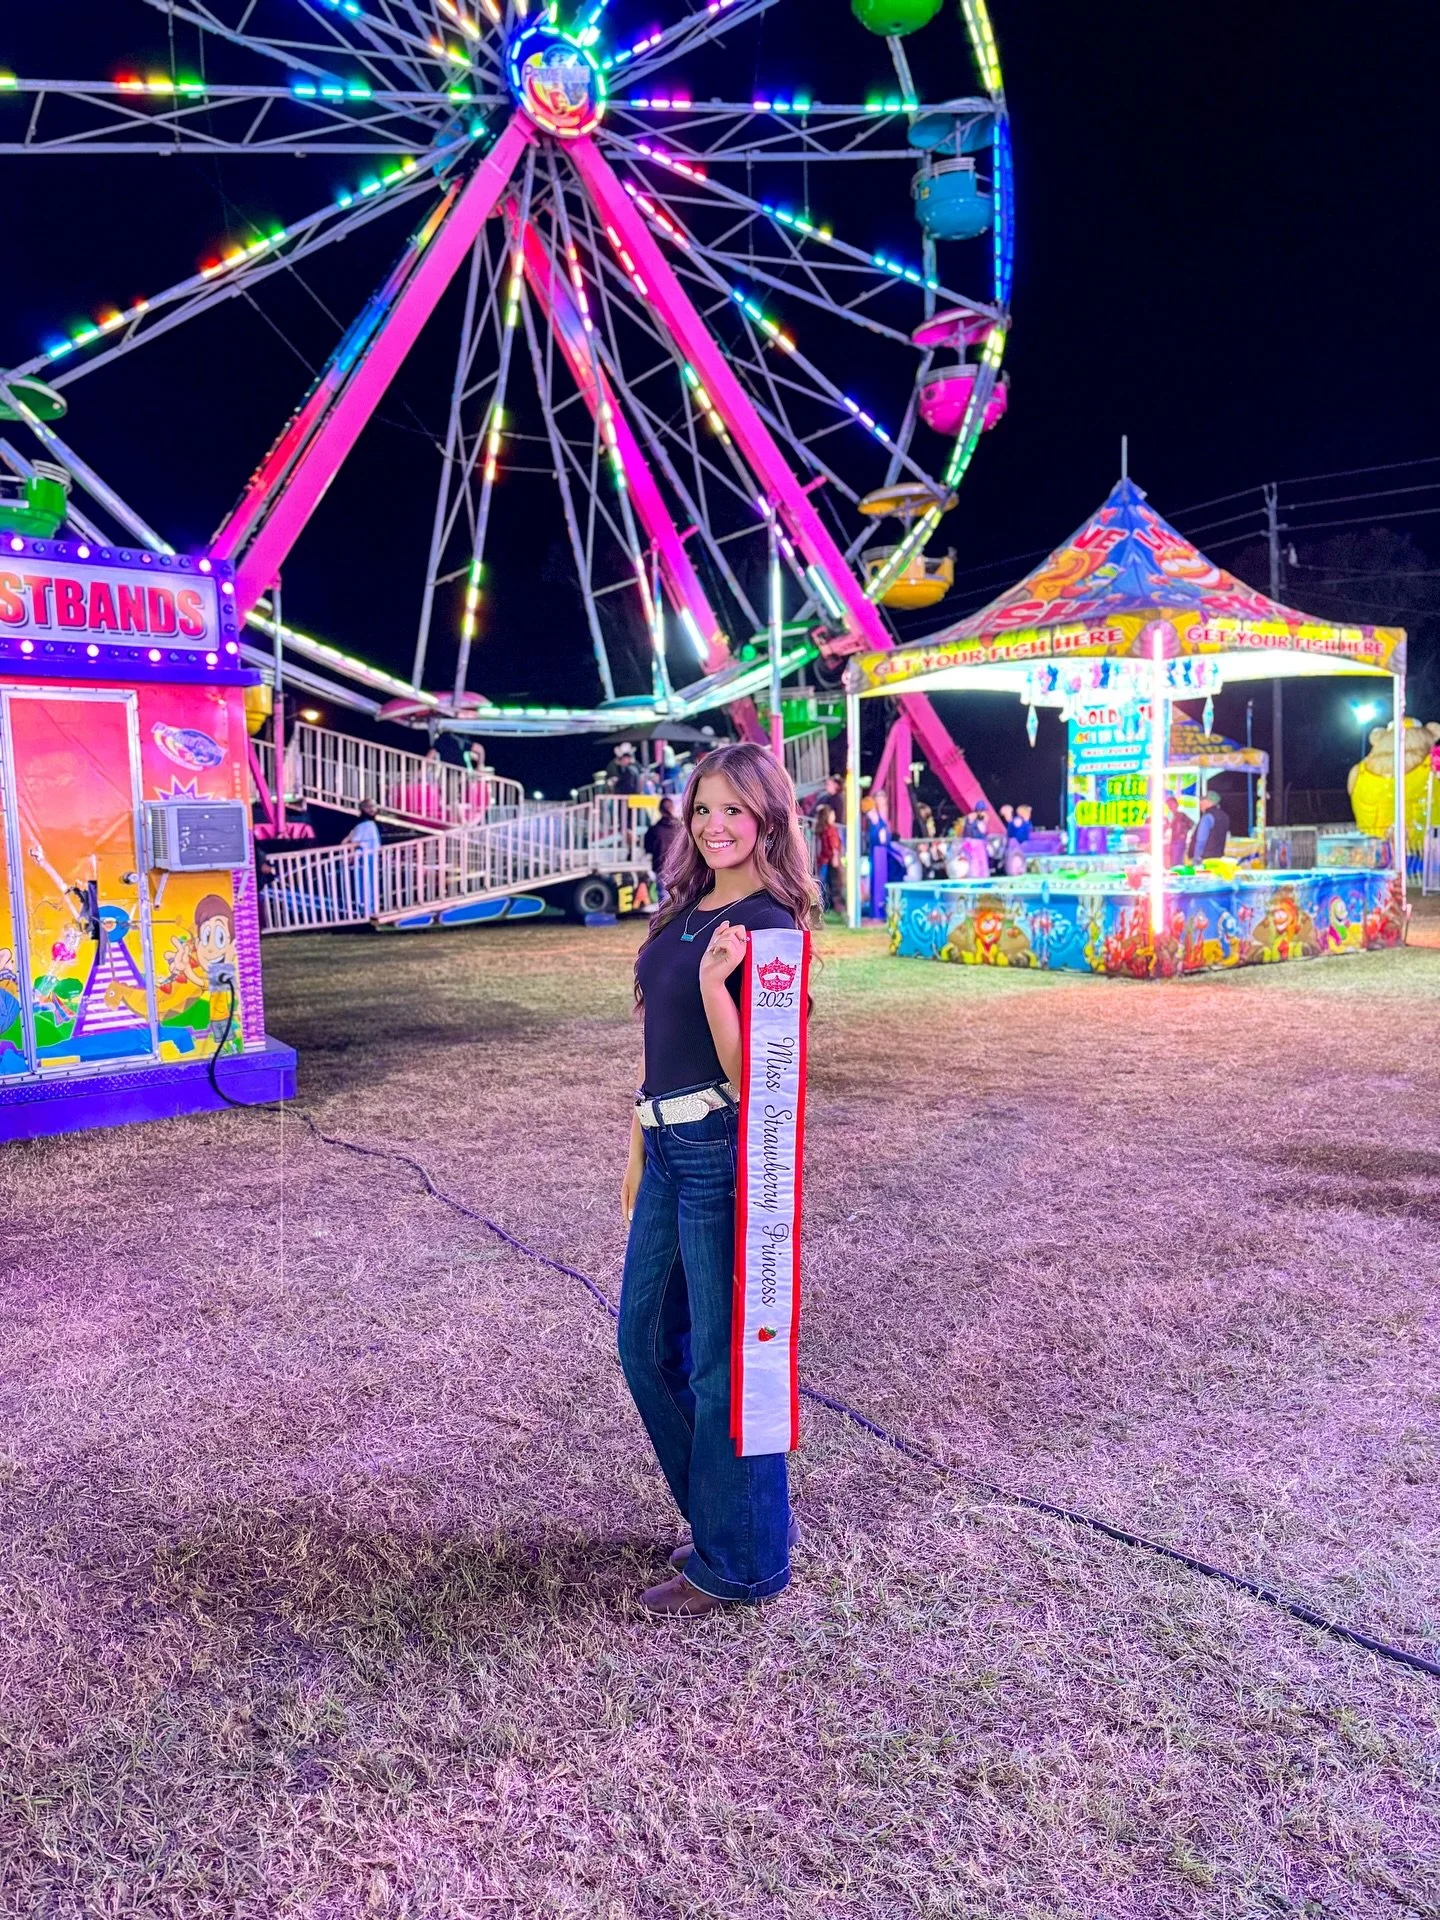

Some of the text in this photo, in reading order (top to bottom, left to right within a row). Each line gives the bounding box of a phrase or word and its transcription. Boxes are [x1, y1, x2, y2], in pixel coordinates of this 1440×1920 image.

[872, 628, 1124, 677] GET YOUR FISH HERE
[1187, 627, 1384, 655] GET YOUR FISH HERE
[756, 991, 795, 1008] 2025
[753, 1037, 795, 1308] Miss Strawberry Princess
